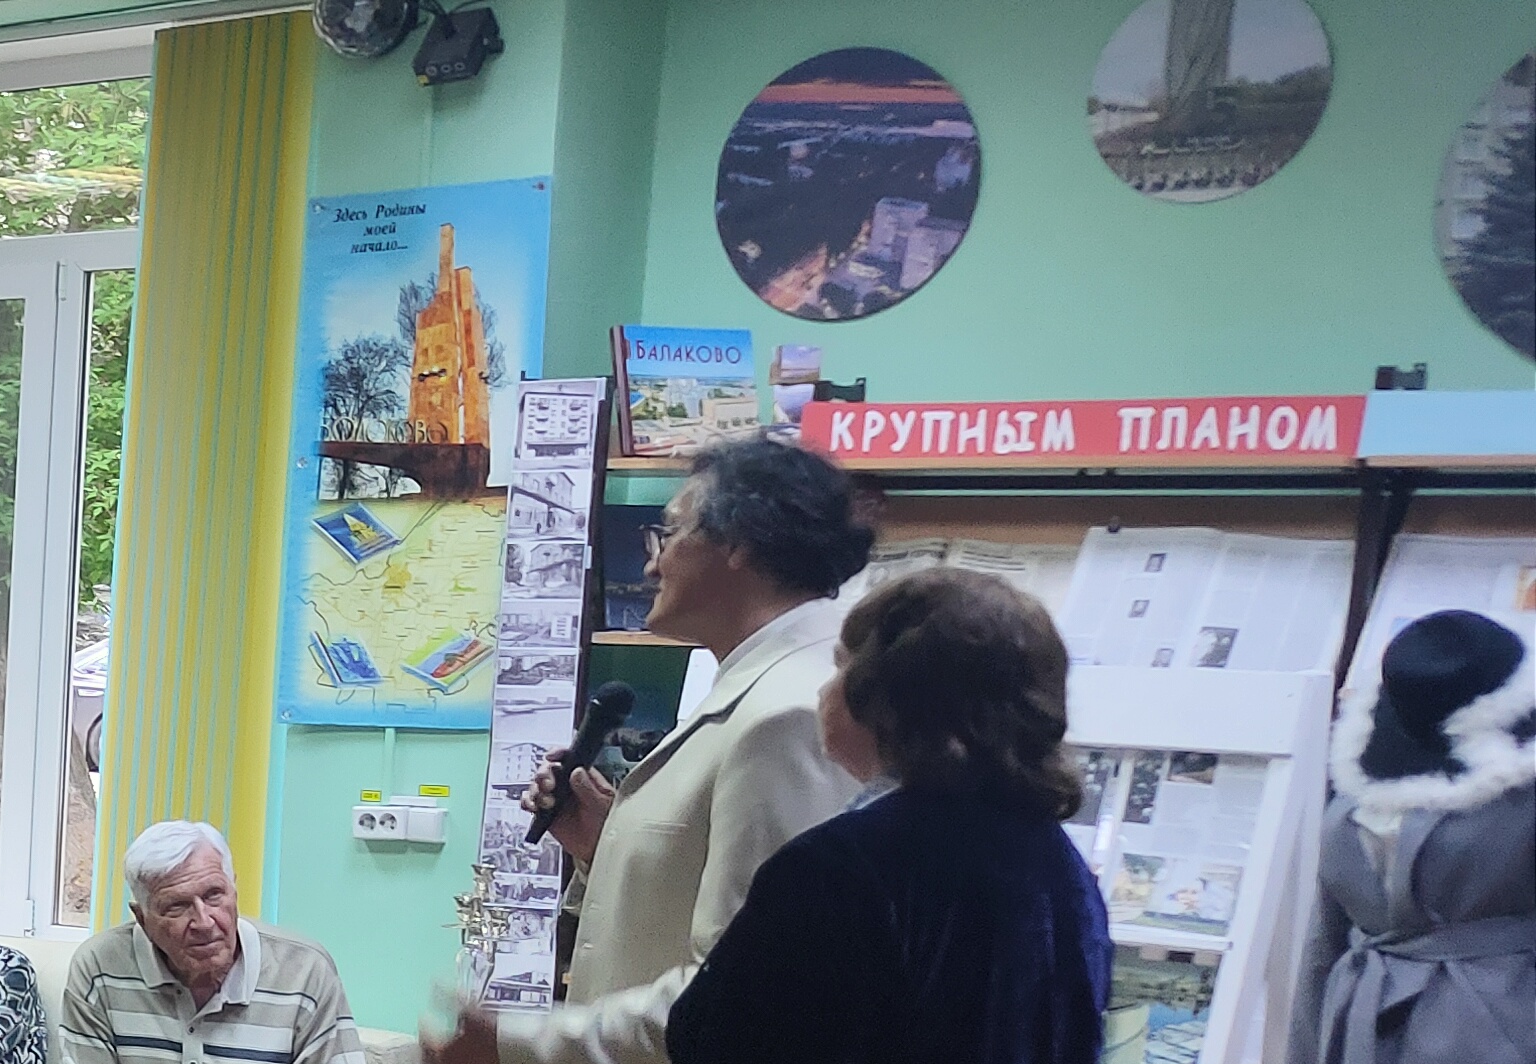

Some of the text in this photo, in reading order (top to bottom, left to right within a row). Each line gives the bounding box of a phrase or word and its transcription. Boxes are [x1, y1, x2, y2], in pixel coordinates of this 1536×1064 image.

[363, 222, 397, 236] моей
[636, 339, 742, 364] БАЛАКОВО
[829, 404, 1338, 454] КРУПНЫМ ПЛАНОМ
